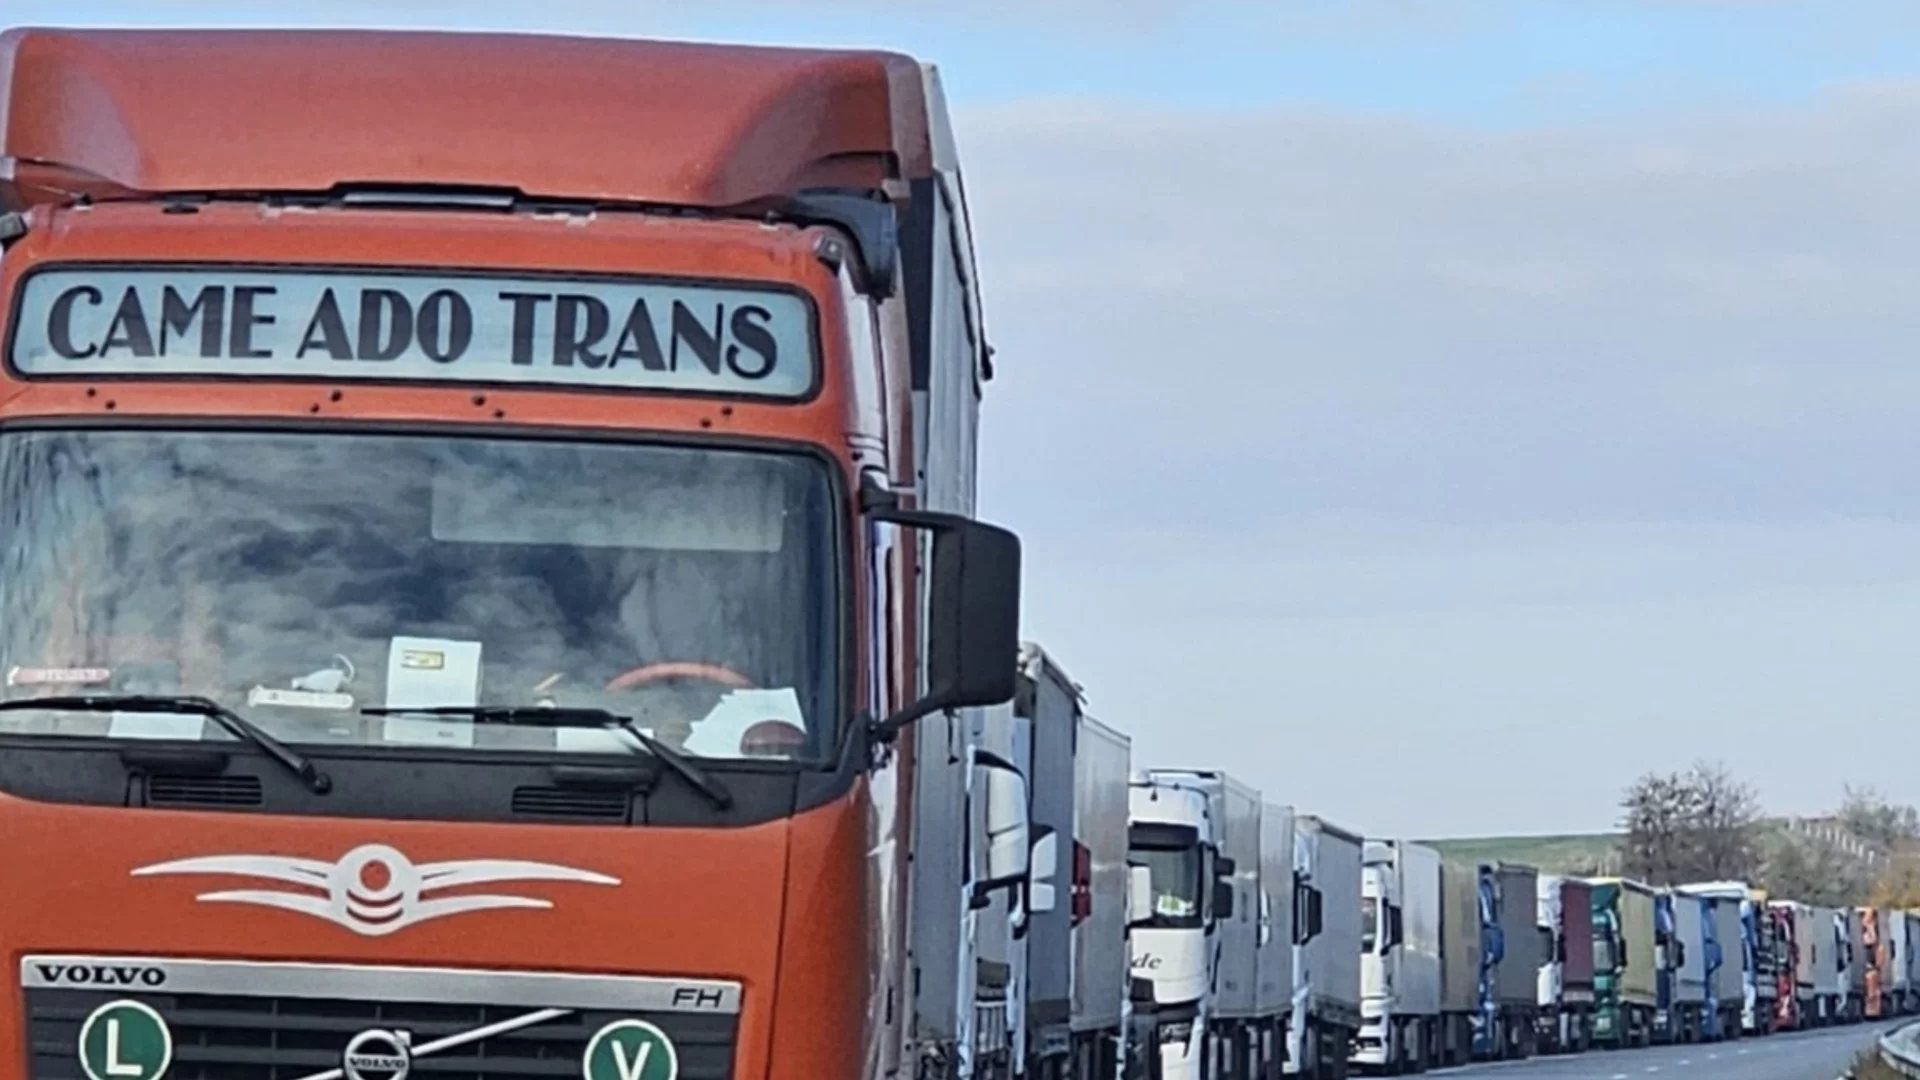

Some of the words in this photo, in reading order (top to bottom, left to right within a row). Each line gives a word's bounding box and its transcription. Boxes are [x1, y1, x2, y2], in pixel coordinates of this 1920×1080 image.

[46, 284, 278, 361] CAME
[295, 288, 474, 364] ADO
[498, 290, 780, 380] TRANS
[36, 964, 166, 986] VOLVO
[672, 987, 723, 1008] FH
[106, 1018, 144, 1077] L
[349, 1057, 406, 1069] VOLVO
[611, 1039, 652, 1080] V
